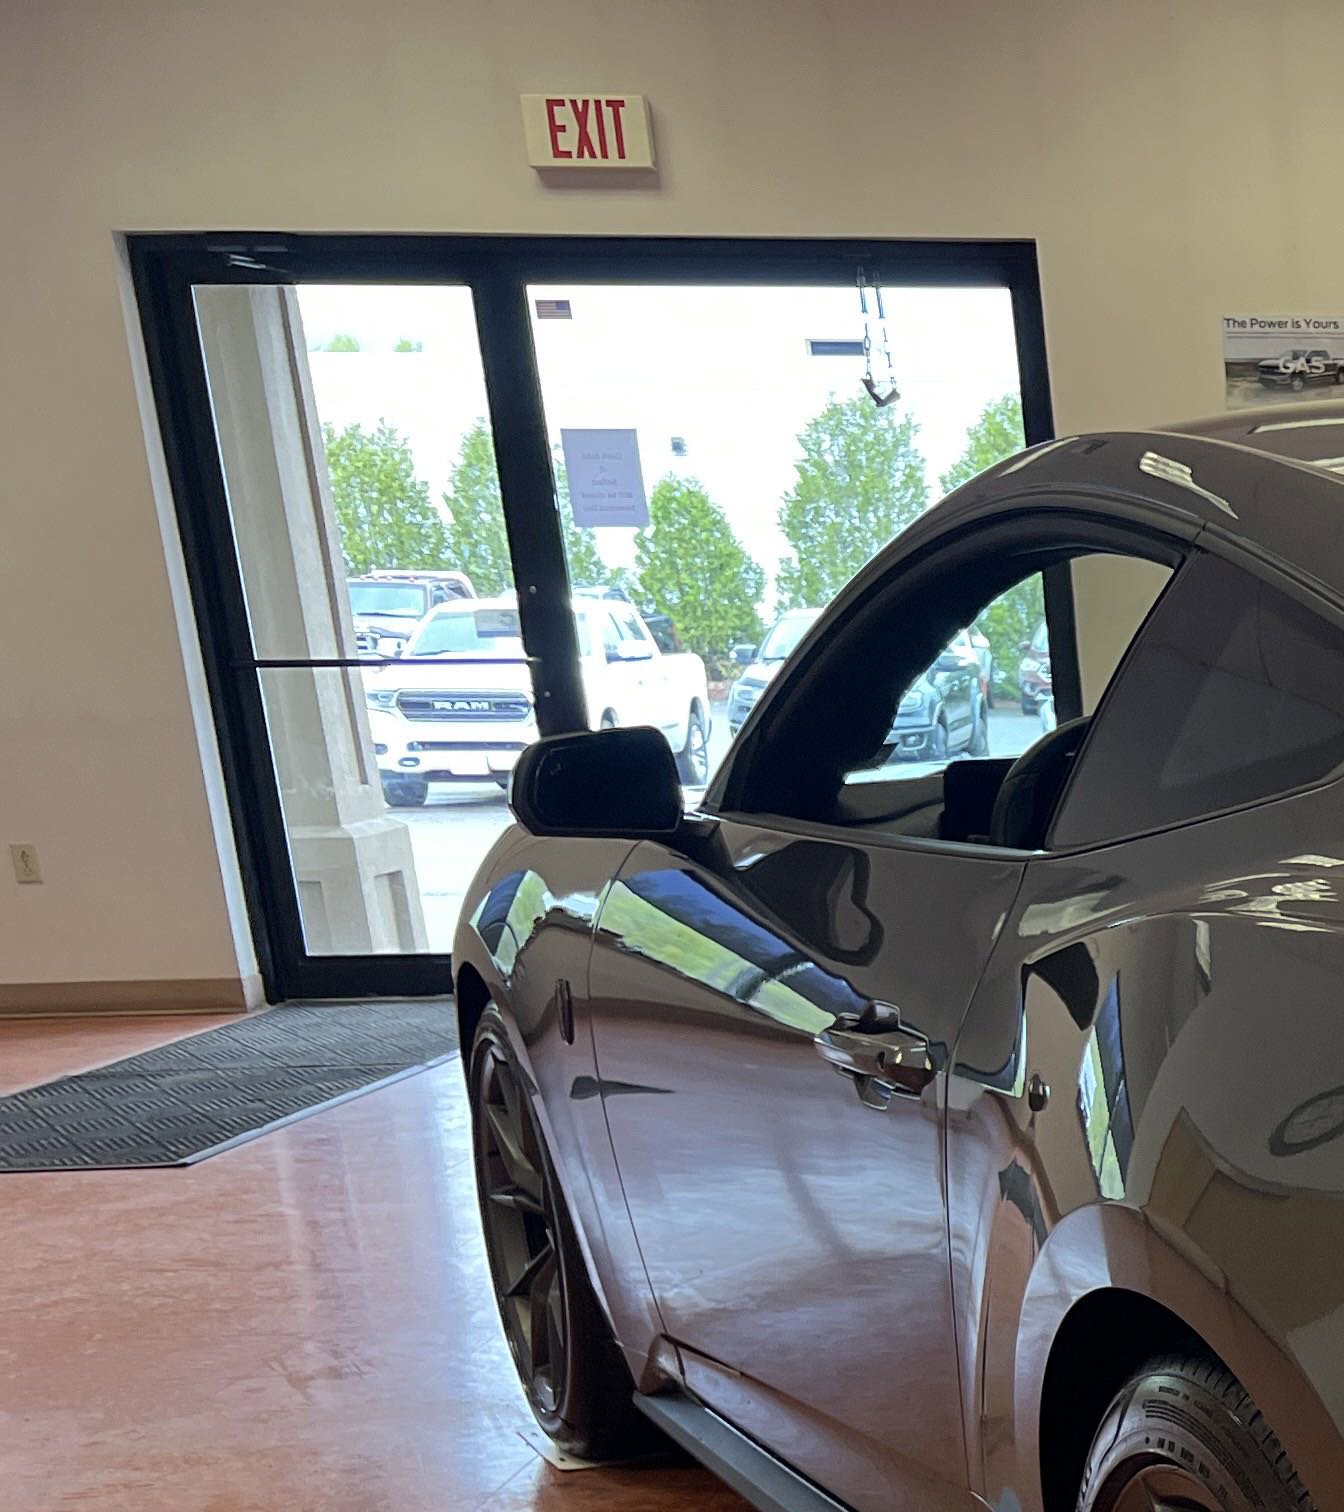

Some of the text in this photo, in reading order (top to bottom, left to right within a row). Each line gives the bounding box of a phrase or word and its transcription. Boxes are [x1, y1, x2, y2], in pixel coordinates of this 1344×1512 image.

[546, 99, 626, 160] EXIT
[1224, 318, 1247, 329] The
[1250, 318, 1288, 329] Power
[1303, 318, 1340, 330] Yours
[1279, 356, 1326, 374] GAS
[432, 700, 490, 711] RAM
